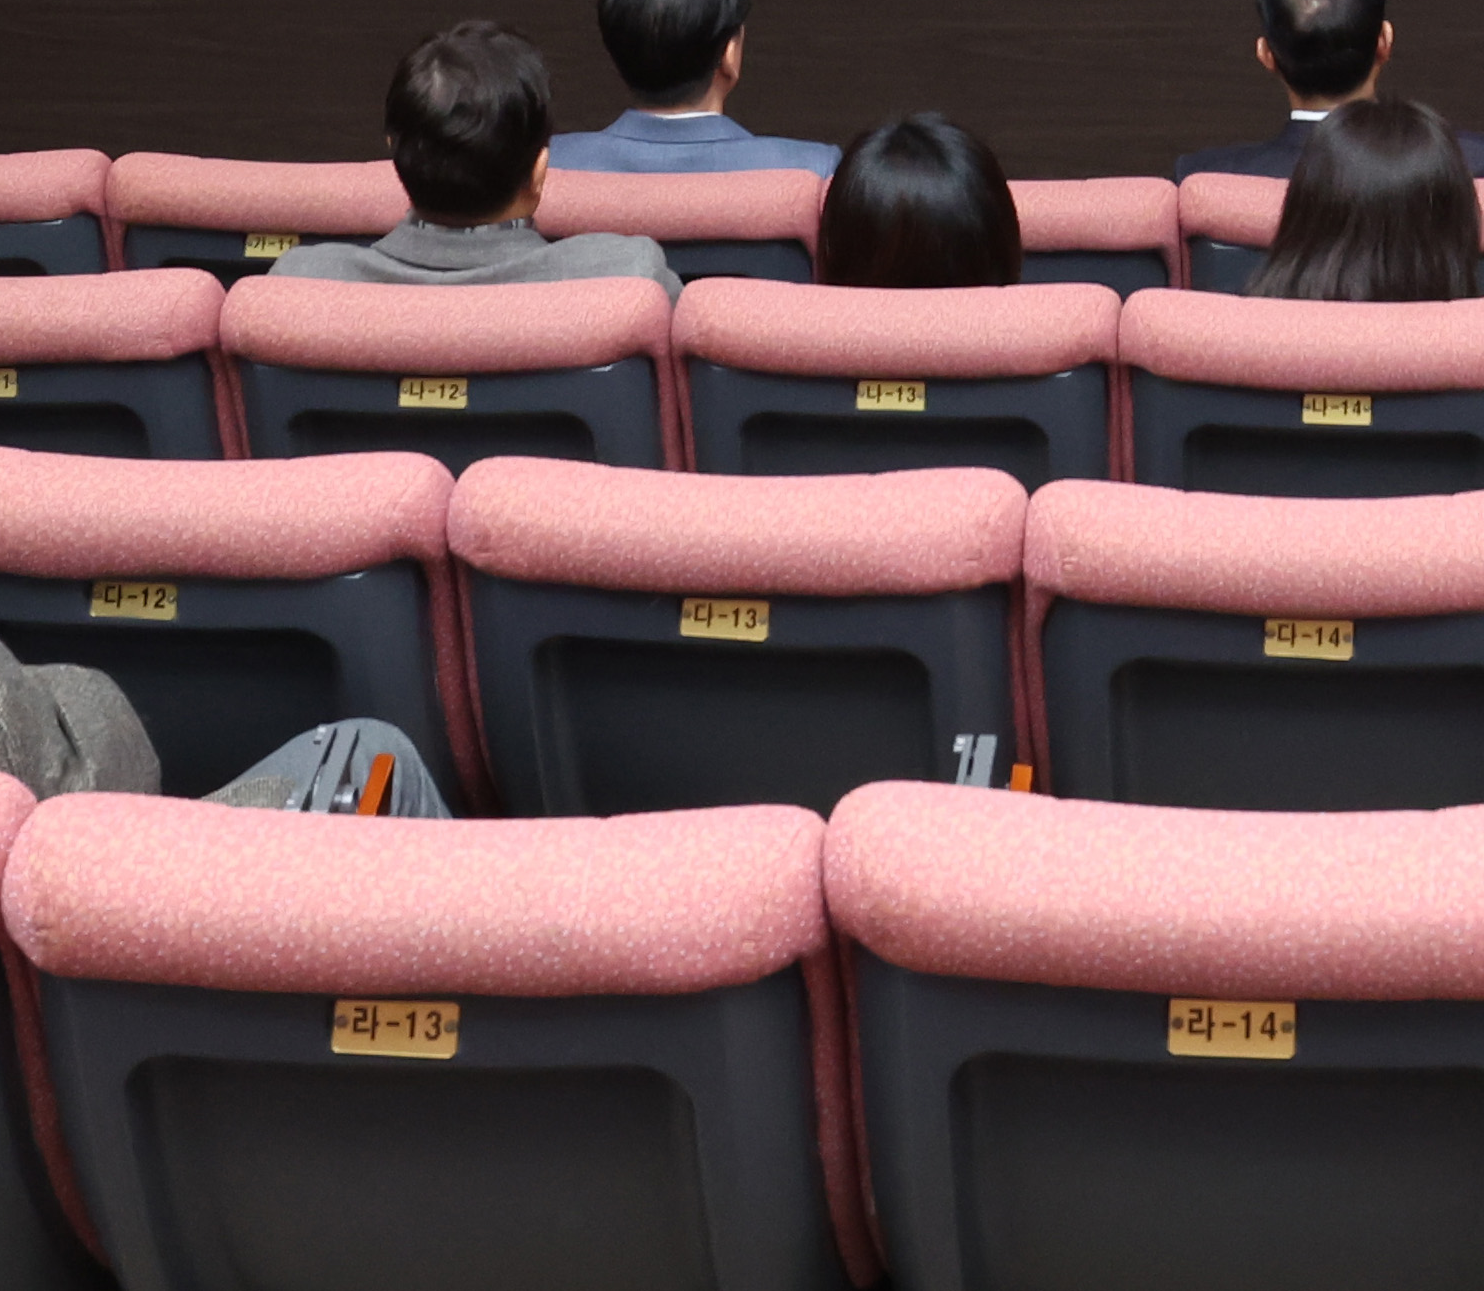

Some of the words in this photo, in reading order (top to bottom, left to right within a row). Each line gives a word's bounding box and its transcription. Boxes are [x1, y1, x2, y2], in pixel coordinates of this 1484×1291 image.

[409, 382, 459, 400] 나-12
[867, 384, 916, 402] 나-13
[1311, 398, 1361, 418] 나-14
[104, 584, 166, 607] 다-12
[693, 603, 757, 630] 다-13
[1277, 622, 1340, 646] 다-14
[352, 1007, 442, 1040] 라-13
[1187, 1005, 1278, 1039] 라-14
